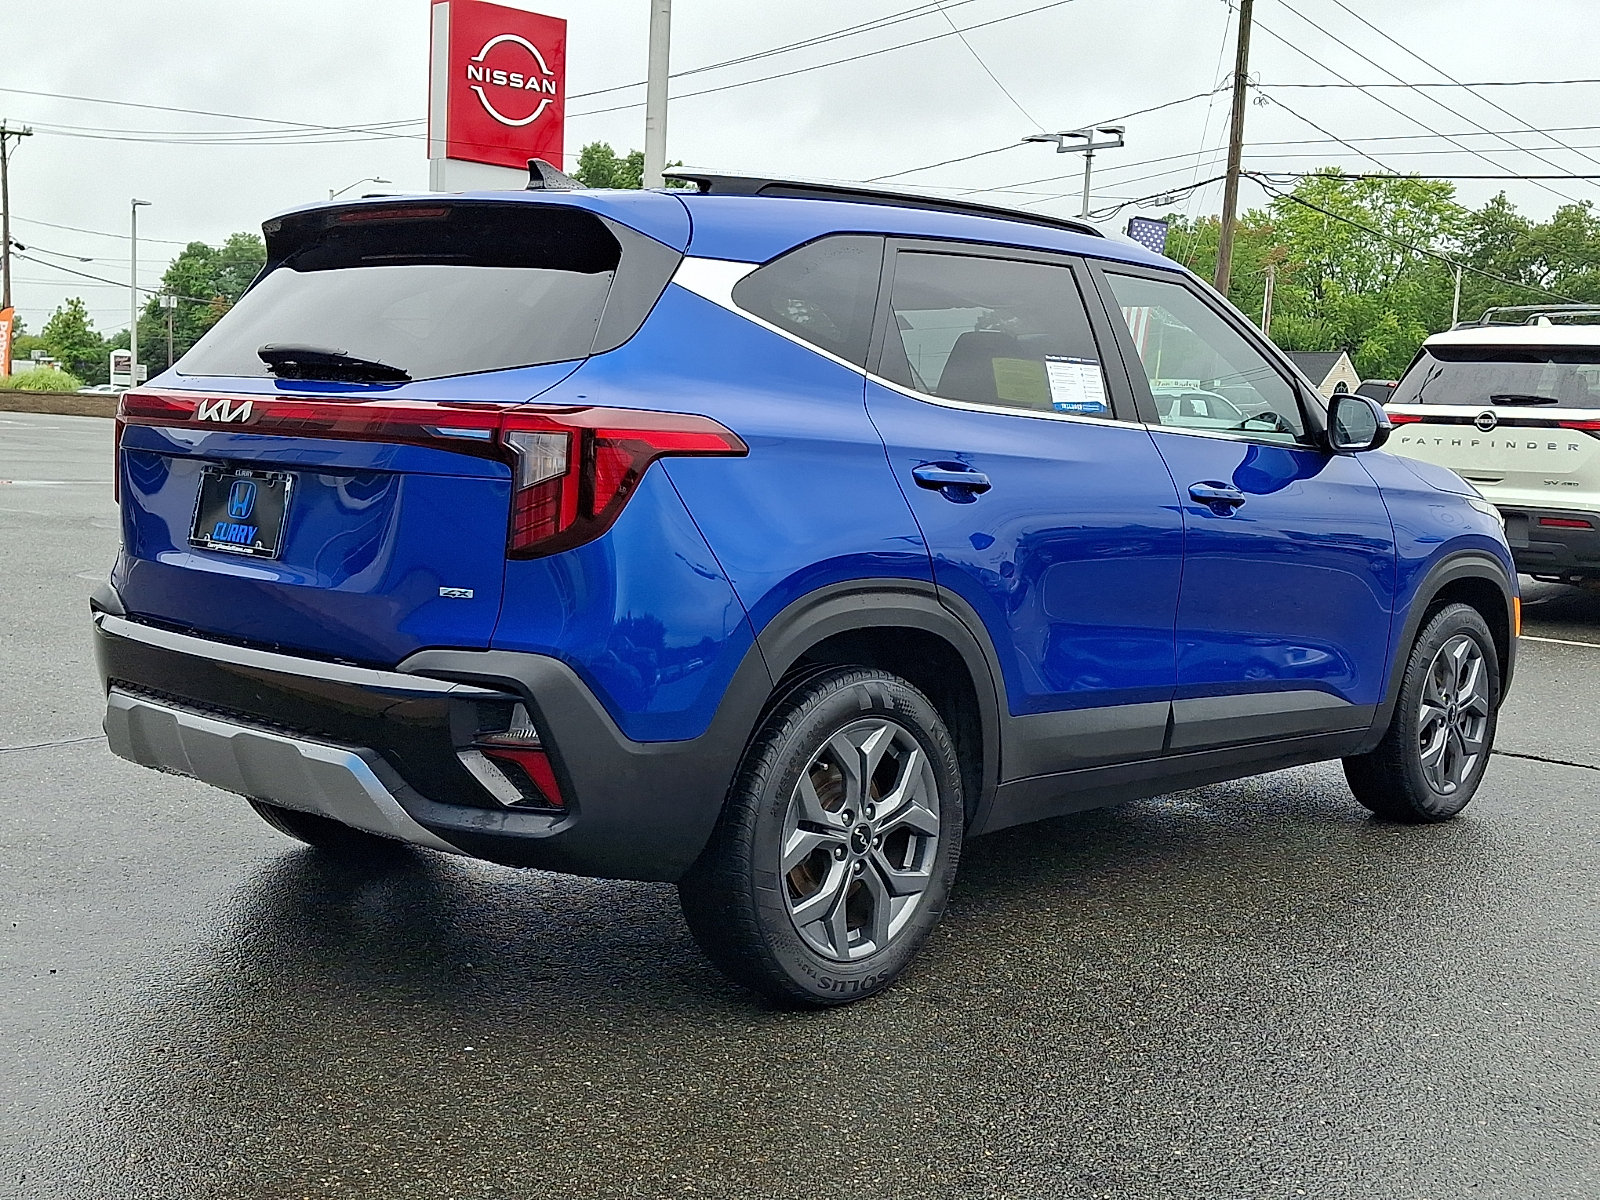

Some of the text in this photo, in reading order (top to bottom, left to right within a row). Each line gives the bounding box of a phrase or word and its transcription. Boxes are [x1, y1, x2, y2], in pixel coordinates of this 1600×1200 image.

[467, 64, 557, 95] NISSAN
[197, 399, 253, 423] KIA
[1401, 437, 1579, 451] PATHFINDER
[212, 520, 259, 544] CURRY
[817, 968, 889, 992] SOLUS
